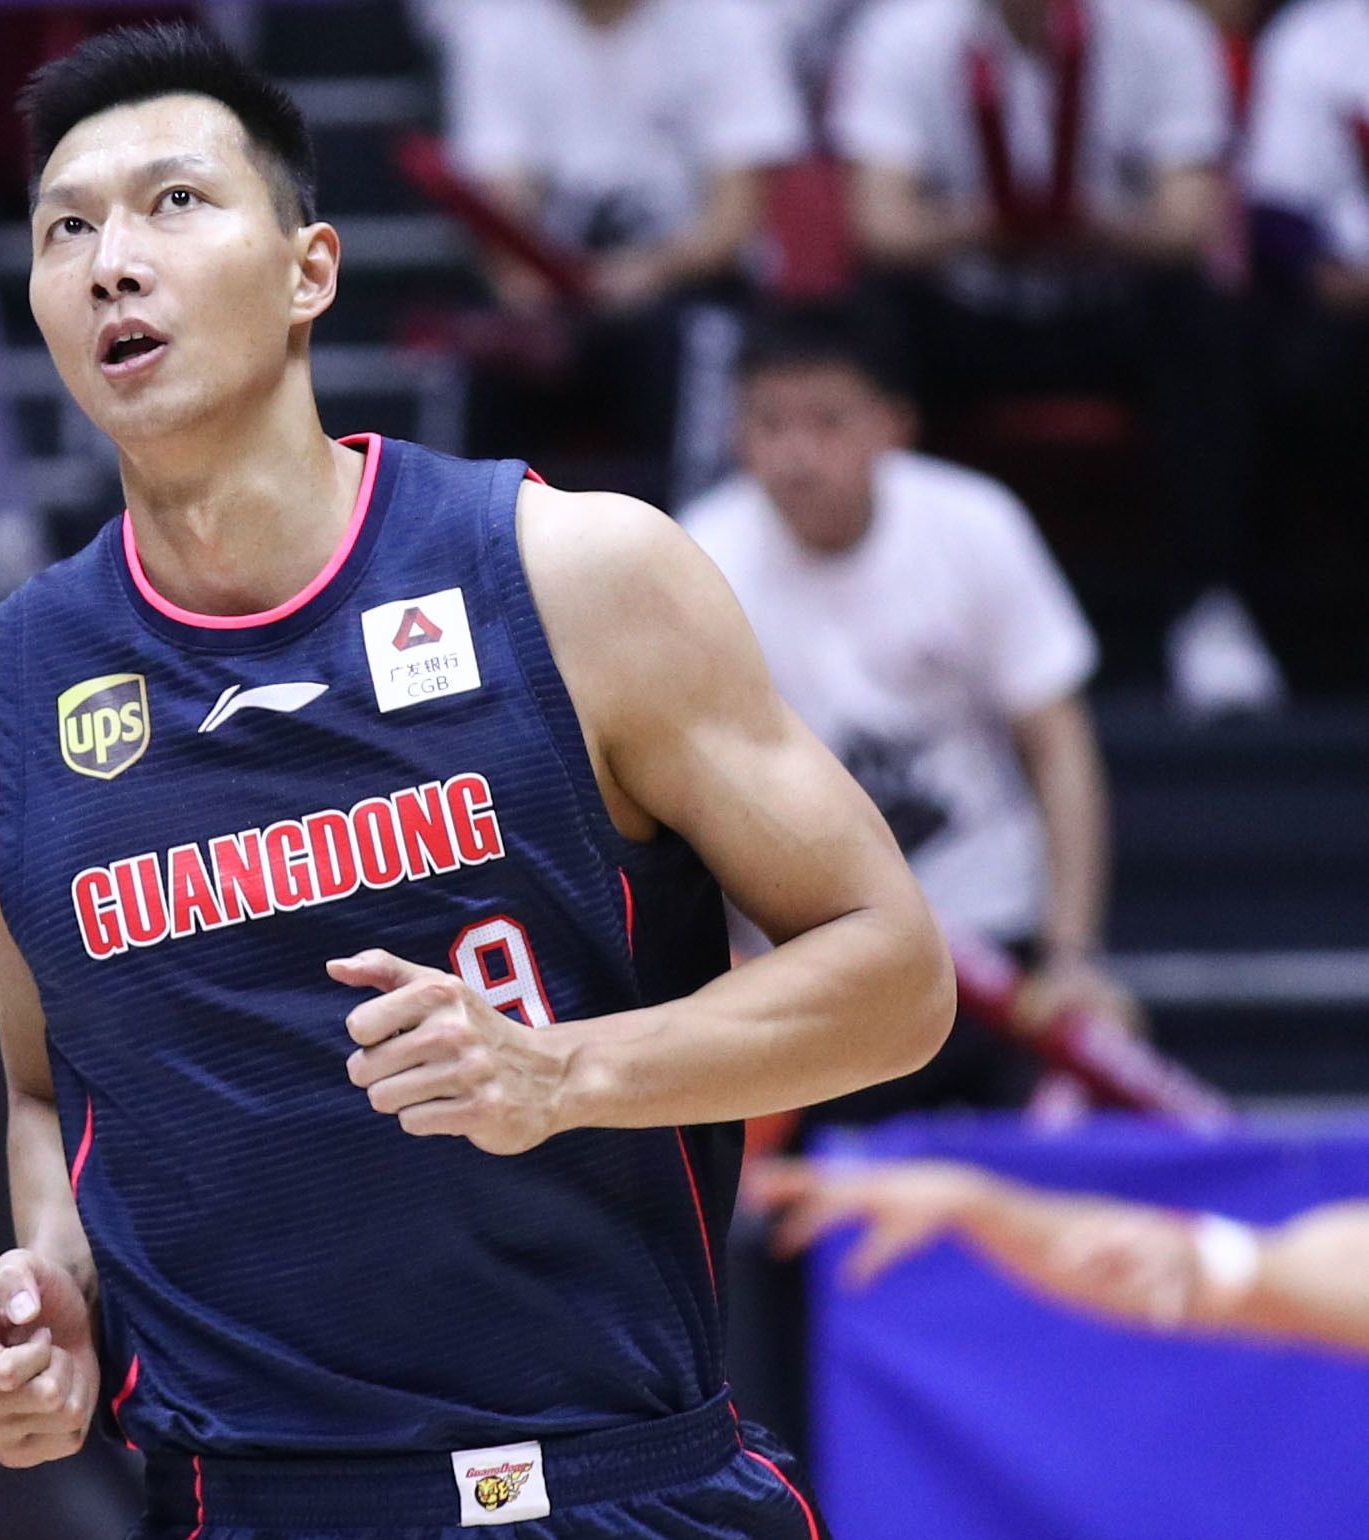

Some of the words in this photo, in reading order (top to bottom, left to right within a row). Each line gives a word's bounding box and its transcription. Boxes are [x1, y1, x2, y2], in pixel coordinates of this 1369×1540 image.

[390, 652, 458, 682] 广发银行
[407, 675, 449, 698] CGB
[66, 701, 144, 764] ups
[71, 772, 506, 961] GUANGDONG
